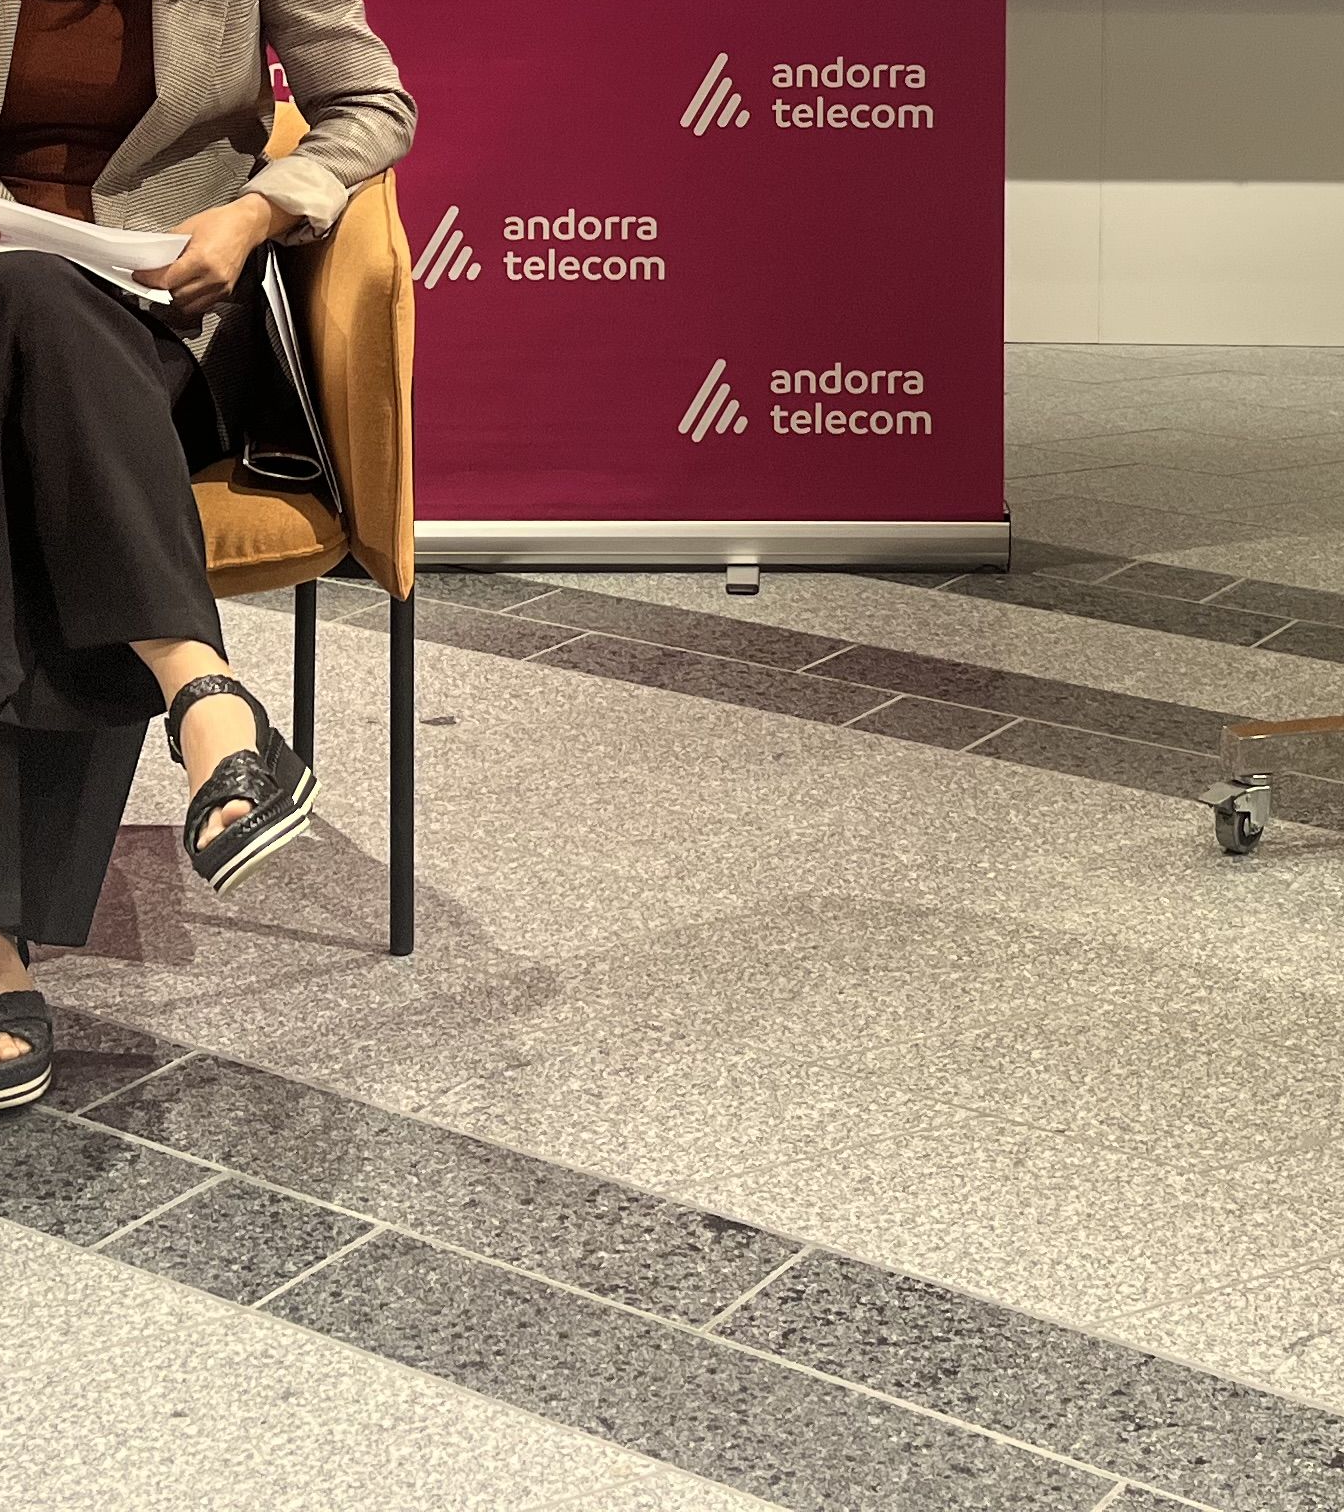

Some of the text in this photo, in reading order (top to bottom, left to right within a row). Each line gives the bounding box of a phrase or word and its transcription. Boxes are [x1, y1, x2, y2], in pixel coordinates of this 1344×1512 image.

[772, 56, 925, 88] andorra
[772, 96, 933, 128] telecom
[504, 208, 657, 240] andorra
[503, 249, 665, 280] telecom
[771, 362, 923, 394] andorra
[770, 403, 931, 434] telecom
